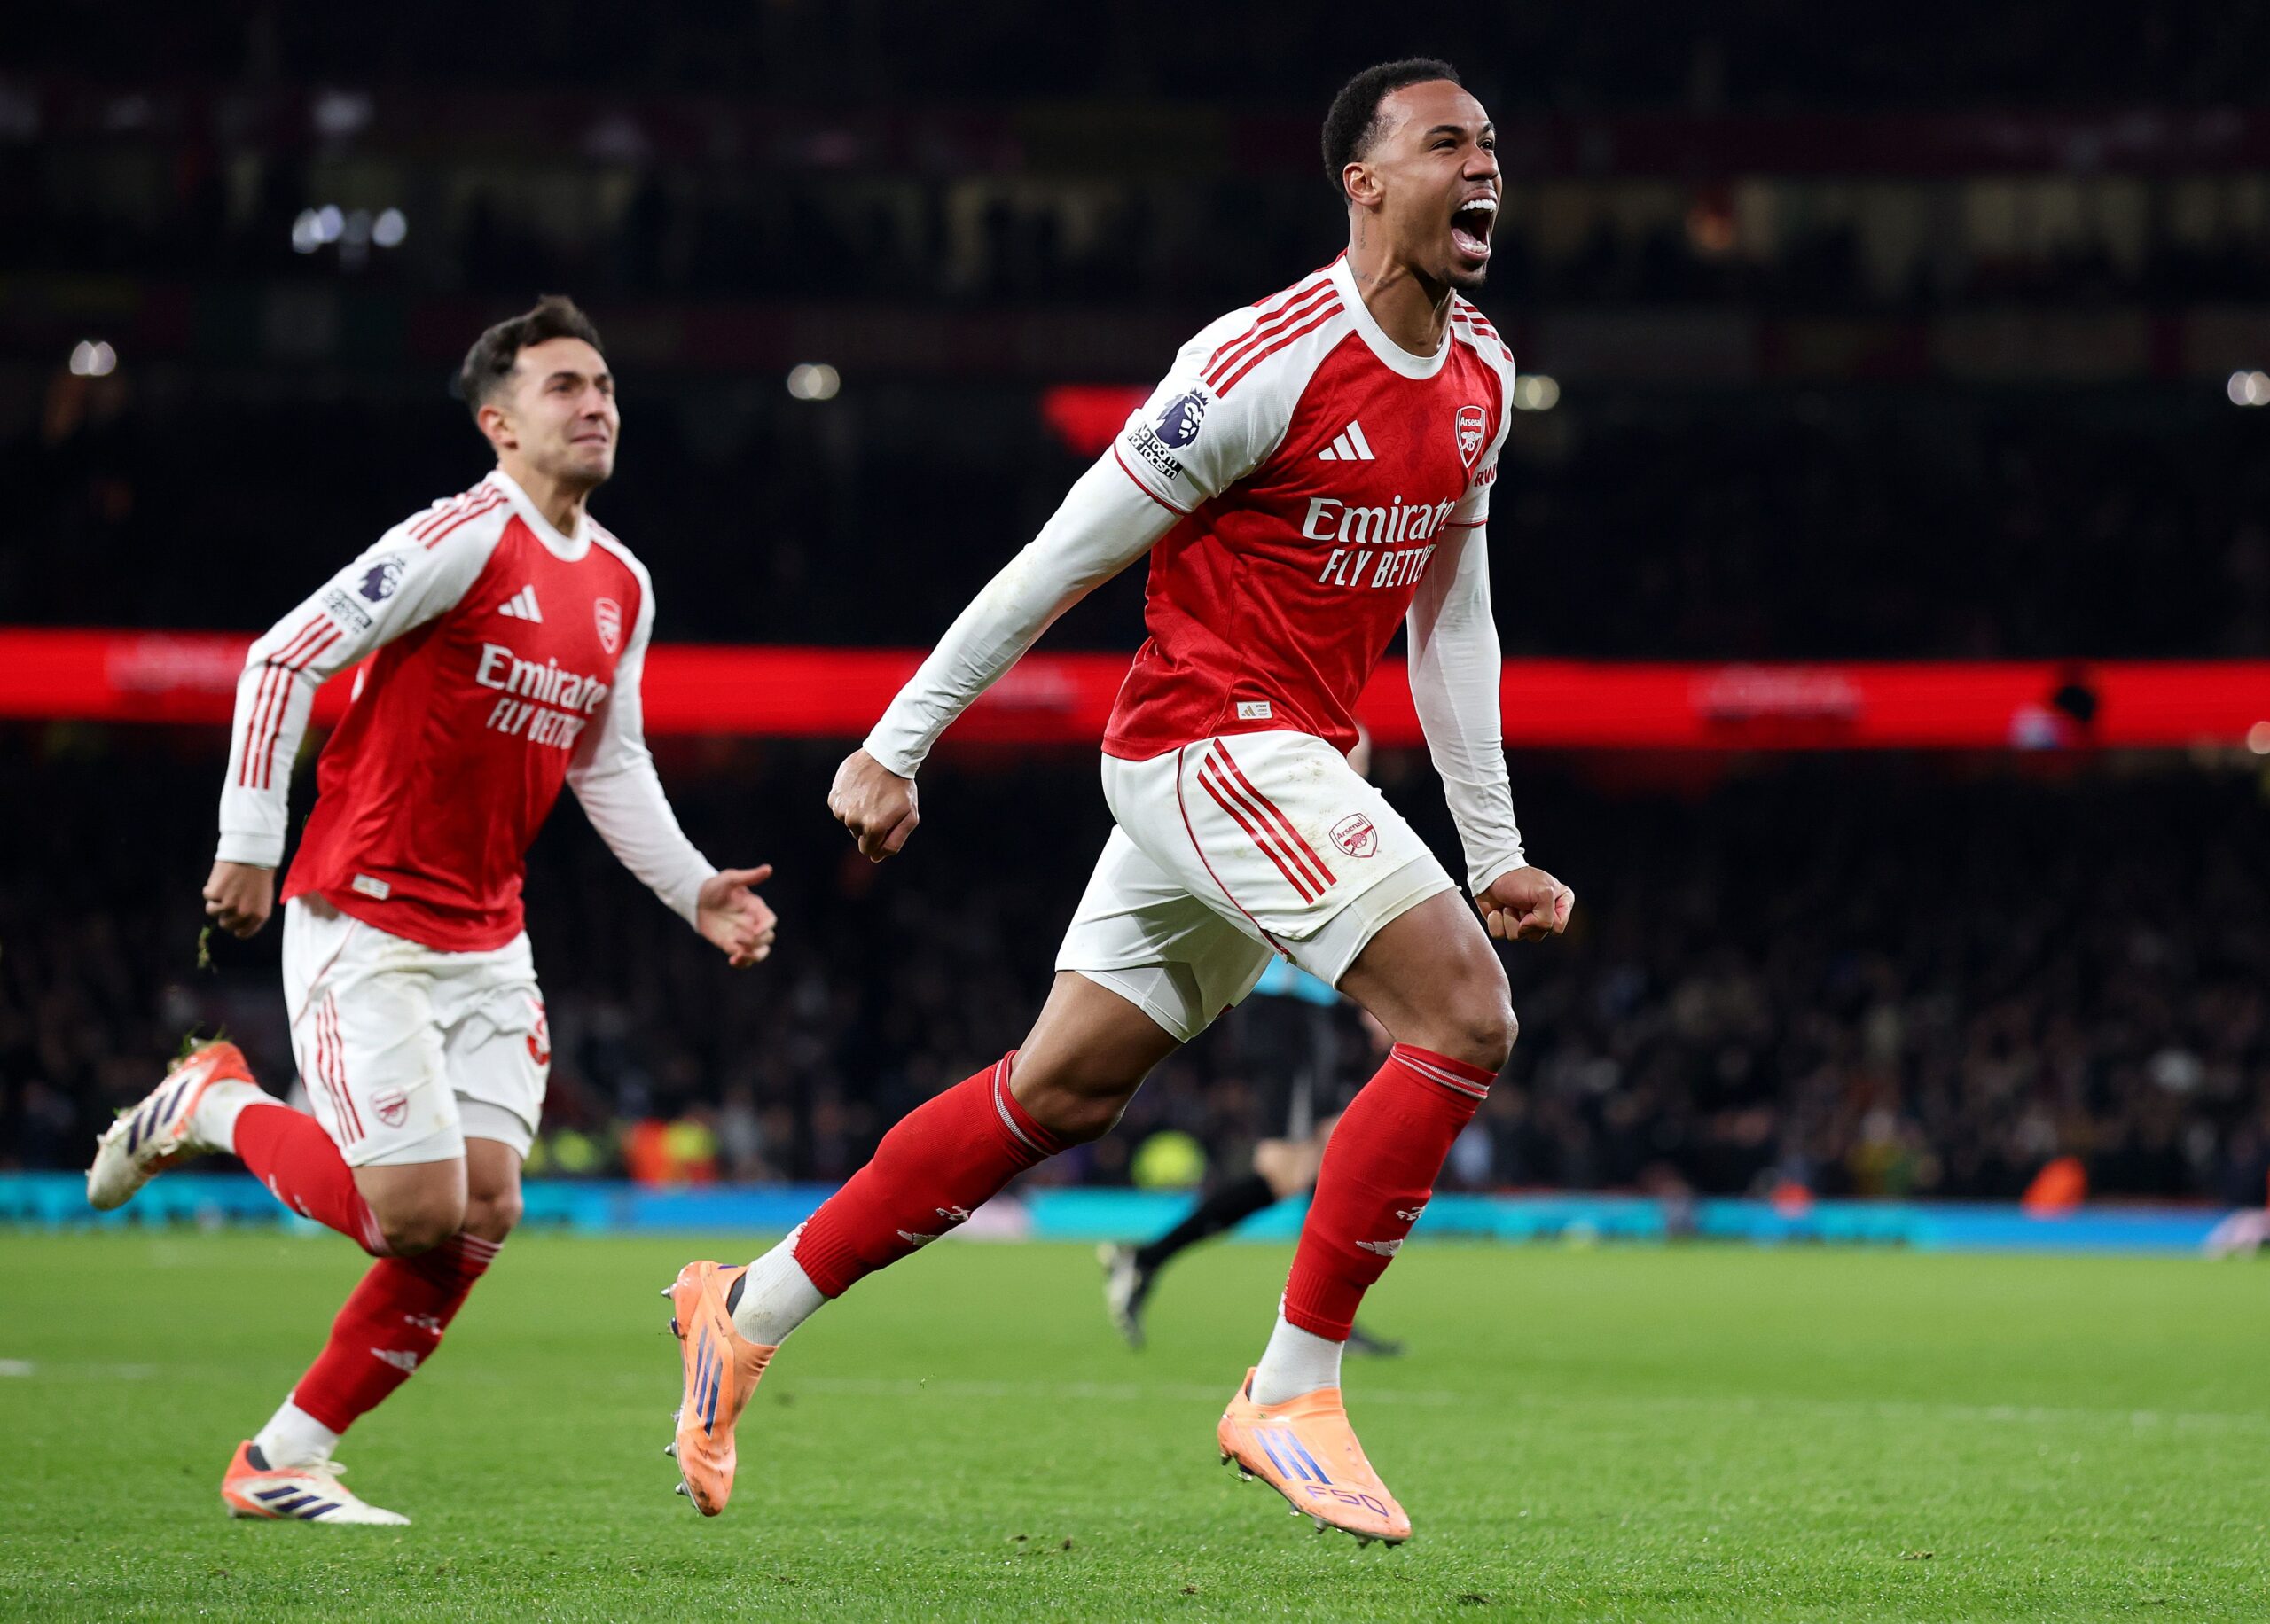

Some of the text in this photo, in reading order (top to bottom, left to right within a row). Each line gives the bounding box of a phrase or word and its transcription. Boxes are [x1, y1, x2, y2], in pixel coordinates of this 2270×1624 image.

[1460, 416, 1483, 426] Arsenal
[1134, 423, 1178, 469] No room
[1139, 443, 1178, 480] racism
[1302, 494, 1457, 543] Emirate
[1319, 548, 1374, 587] FLY
[475, 642, 608, 714] Emirate
[486, 697, 586, 750] FLY BETTE
[1335, 818, 1365, 840] Arsenal
